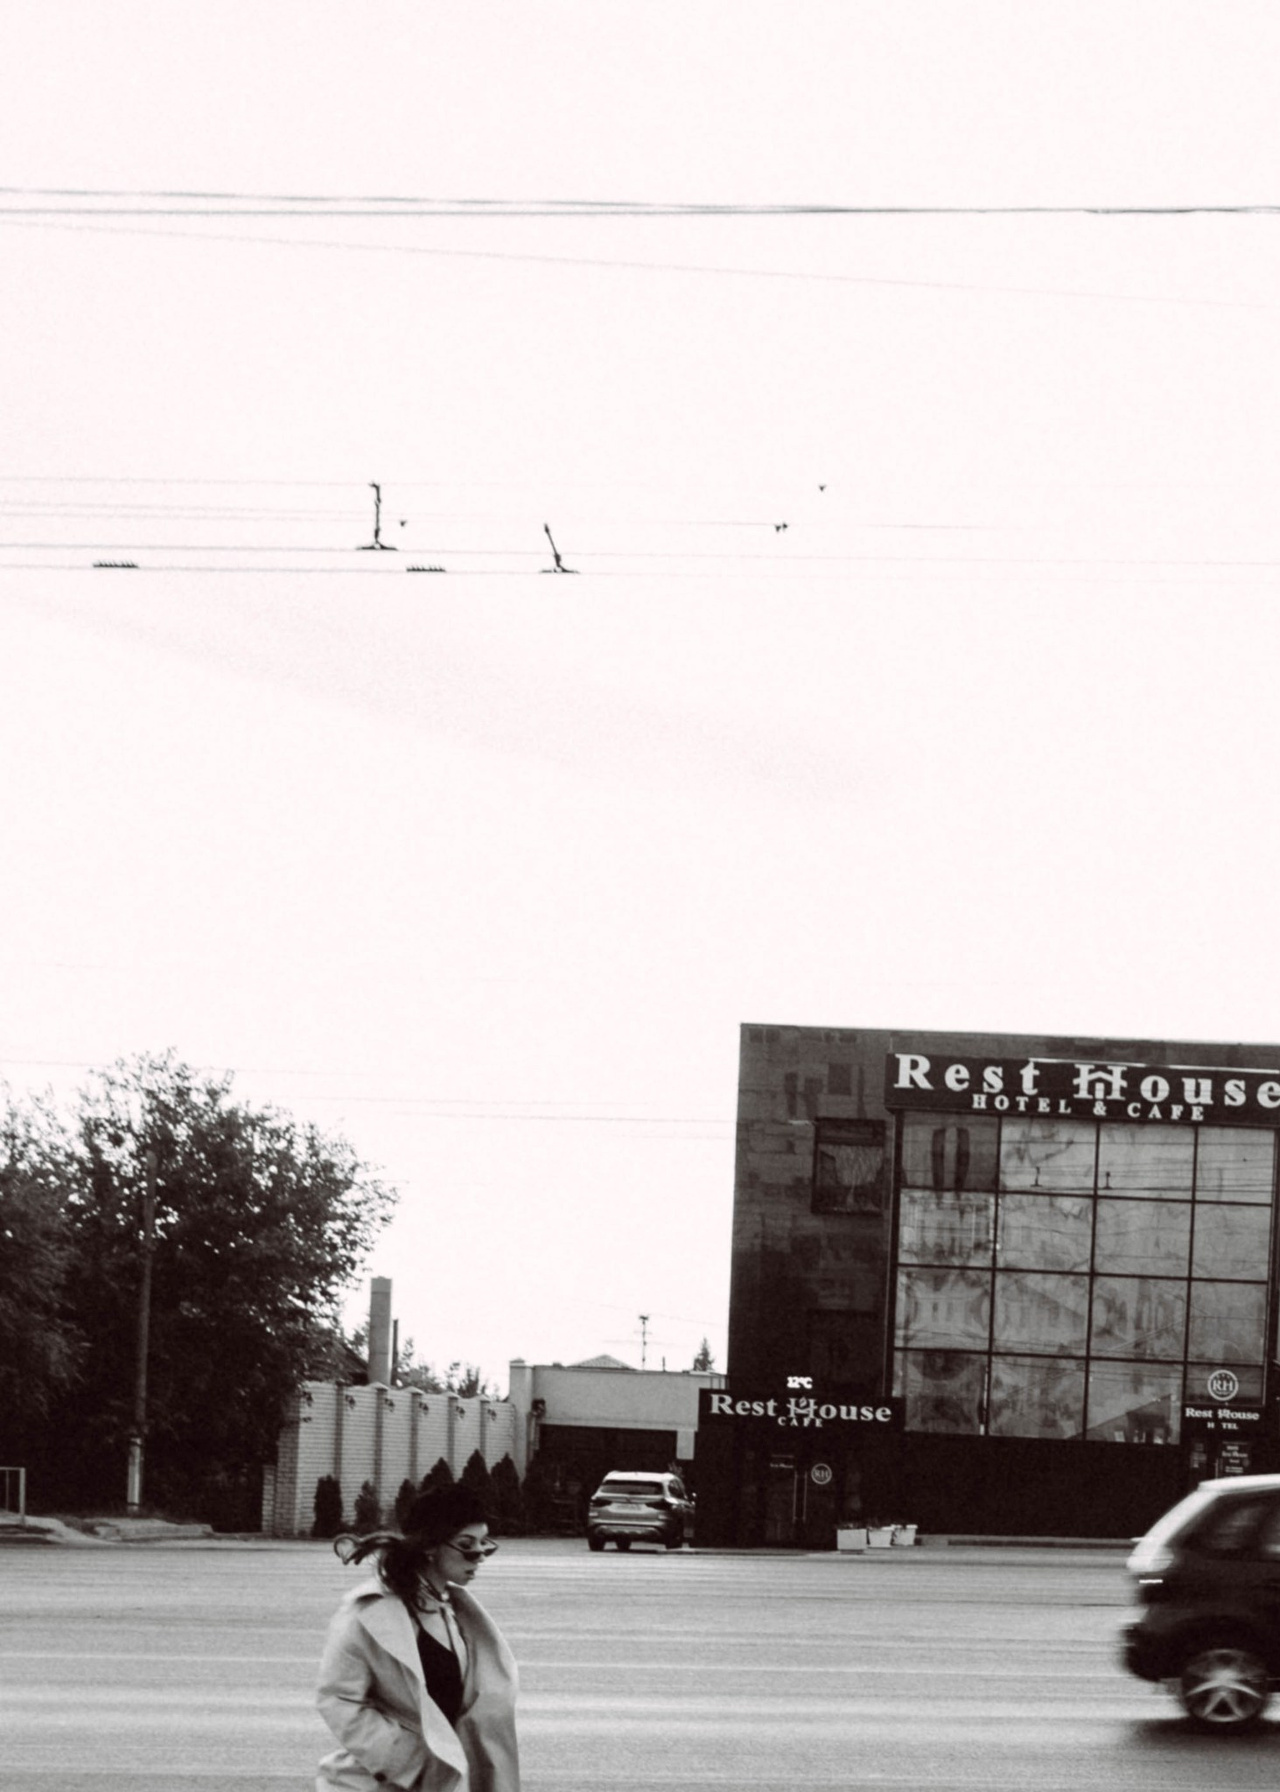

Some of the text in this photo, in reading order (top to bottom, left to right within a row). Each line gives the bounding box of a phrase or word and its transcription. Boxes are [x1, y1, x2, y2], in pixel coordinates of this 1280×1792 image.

[893, 1053, 1040, 1095] Rest
[972, 1094, 1205, 1121] HOTEL & CAFE
[710, 1394, 892, 1422] Rest House
[777, 1416, 823, 1427] CAFE
[1185, 1407, 1260, 1420] Rest House
